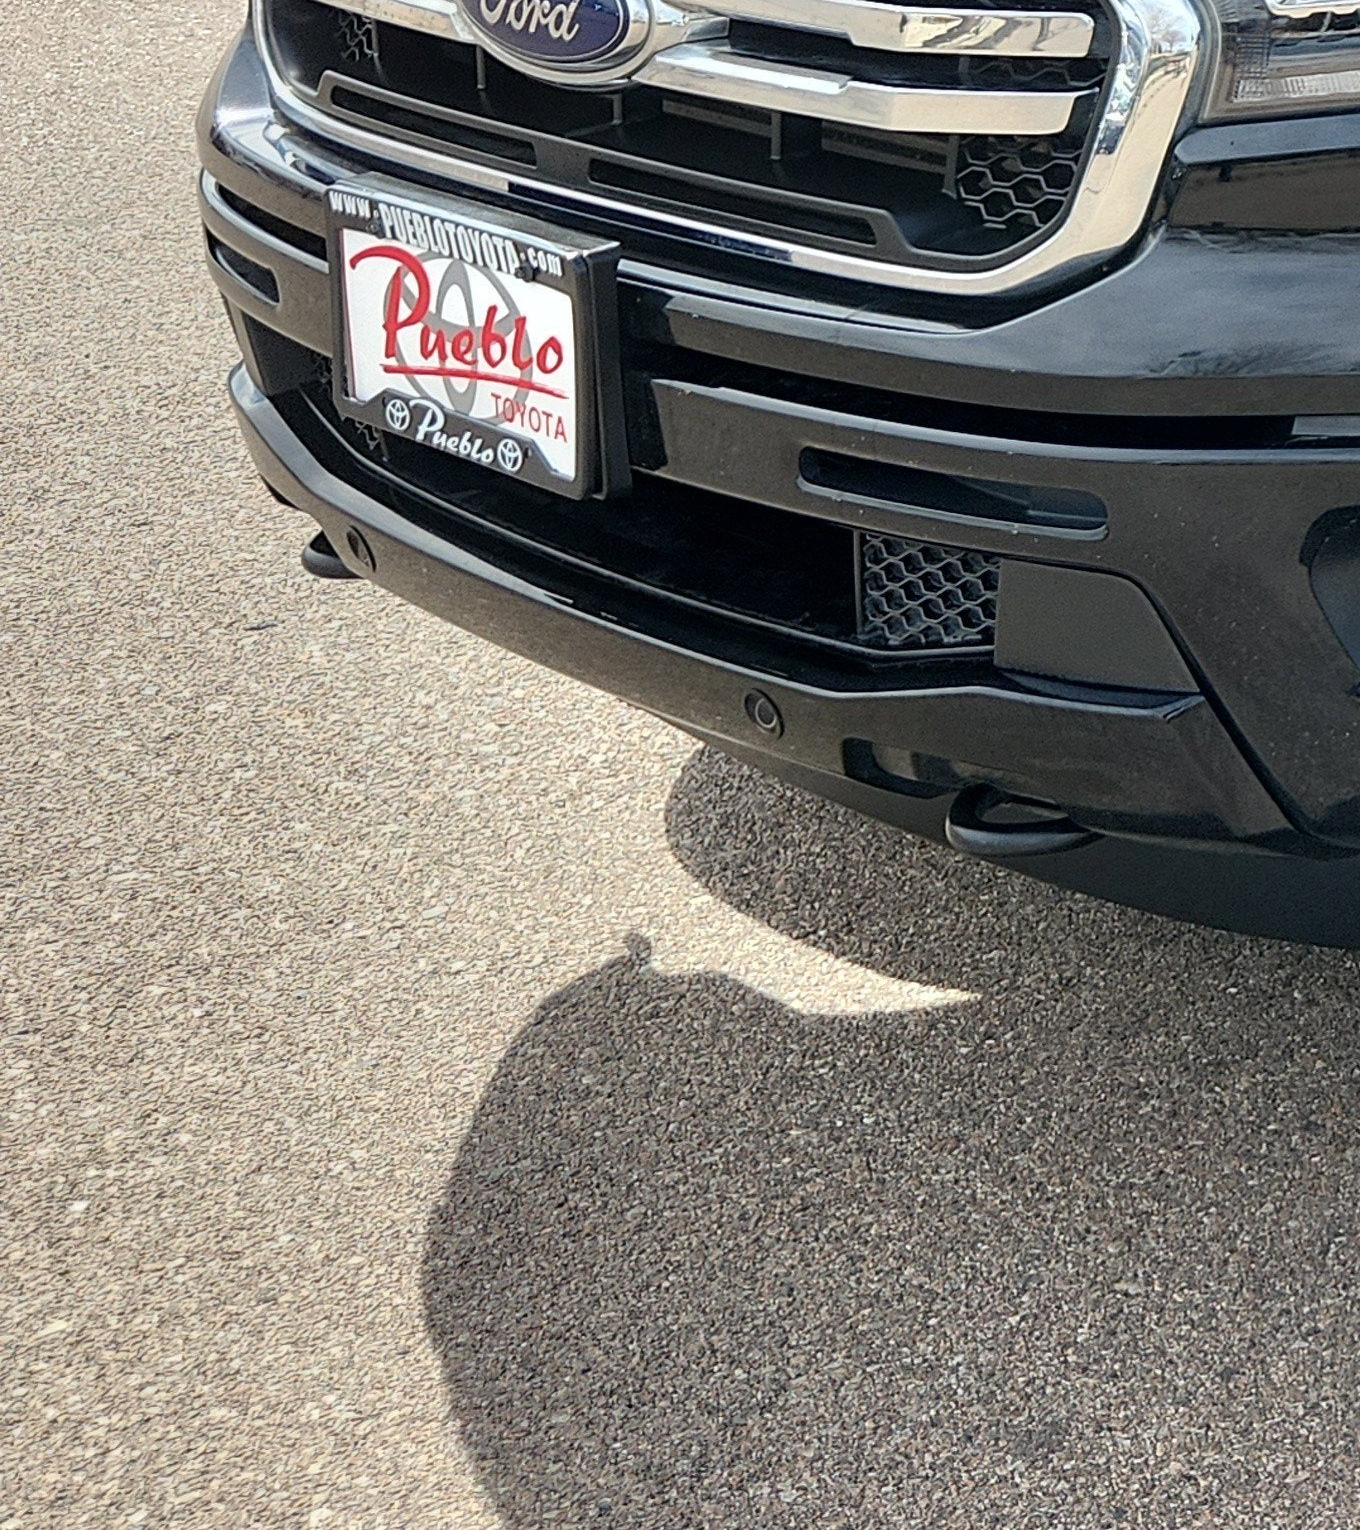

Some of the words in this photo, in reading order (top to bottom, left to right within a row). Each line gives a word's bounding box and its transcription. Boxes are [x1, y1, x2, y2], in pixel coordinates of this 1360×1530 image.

[349, 245, 564, 374] Pueblo
[409, 398, 495, 464] Pueblo
[490, 393, 568, 444] TOYOTA
